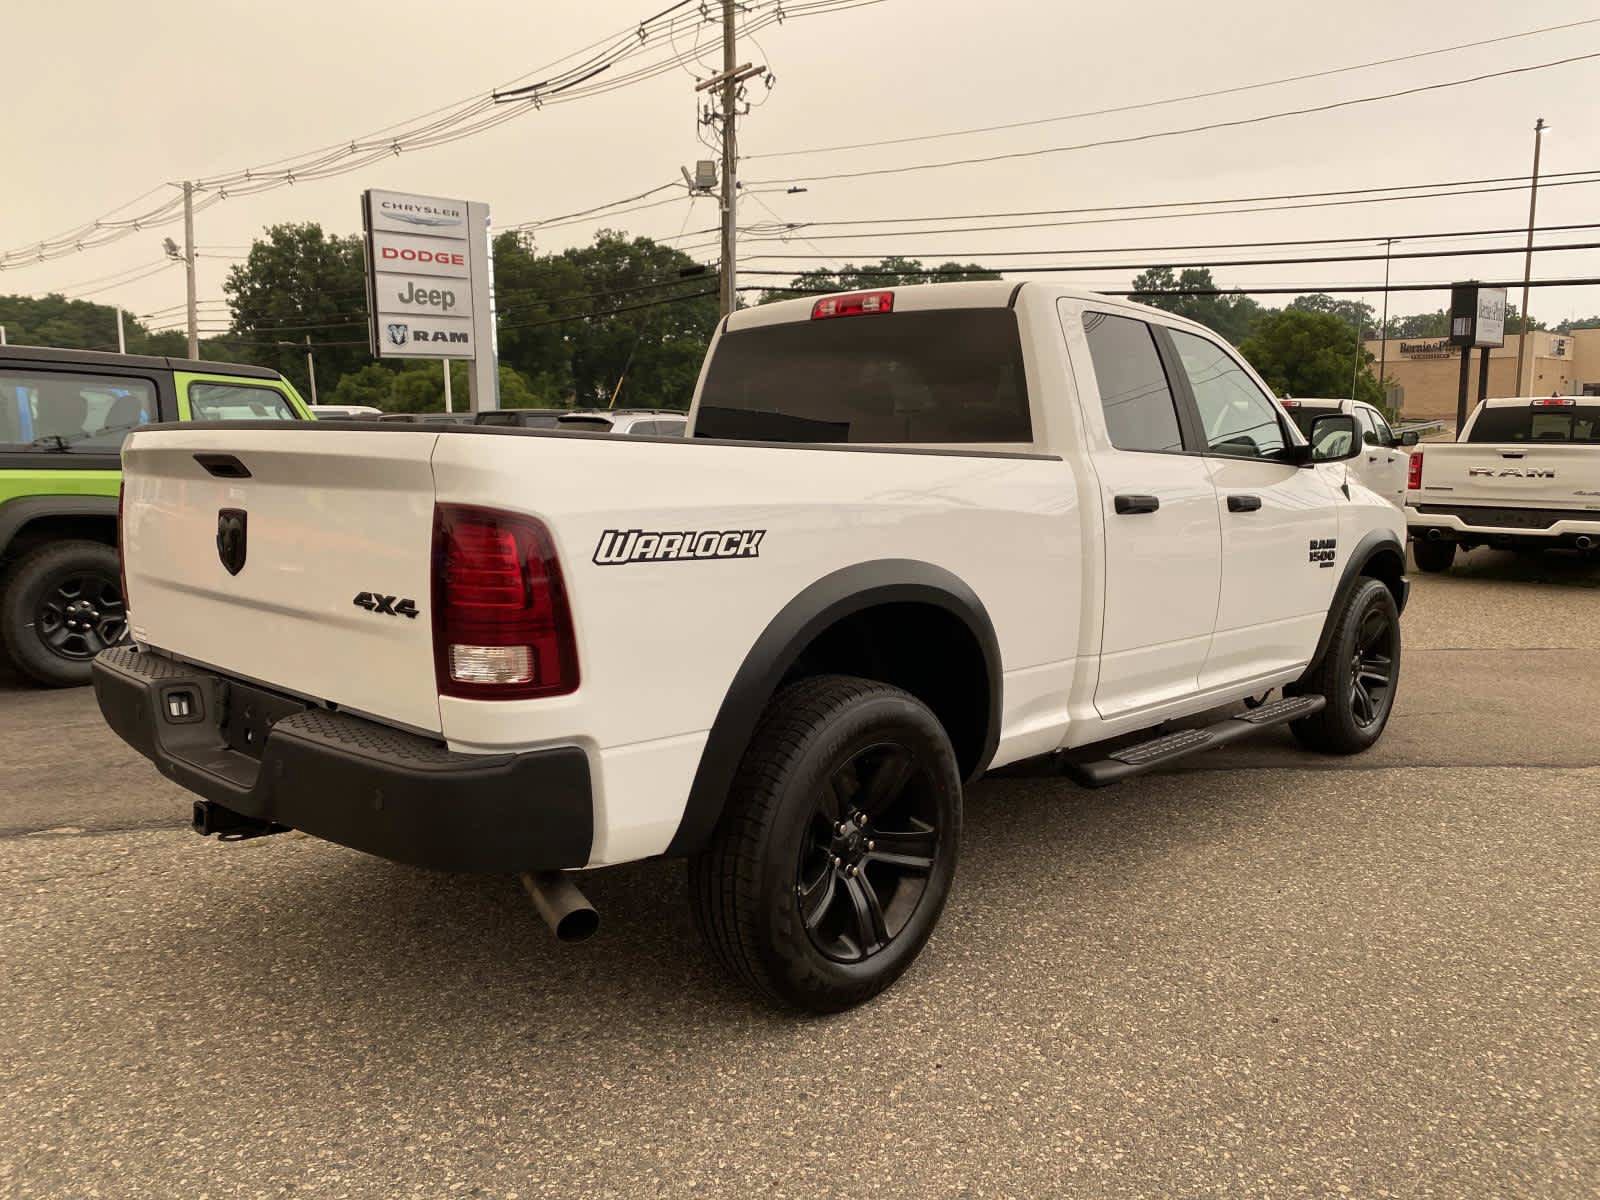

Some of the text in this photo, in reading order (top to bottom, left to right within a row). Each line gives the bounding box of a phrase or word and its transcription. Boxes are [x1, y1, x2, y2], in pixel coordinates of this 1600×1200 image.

[381, 201, 460, 217] CHRYSLER
[381, 247, 465, 266] DODGE
[398, 281, 456, 311] Jeep
[412, 330, 469, 343] RAM
[1468, 467, 1555, 479] RAM
[592, 529, 767, 565] WARLOCK
[1309, 539, 1336, 550] RAM
[1309, 550, 1335, 562] 1500
